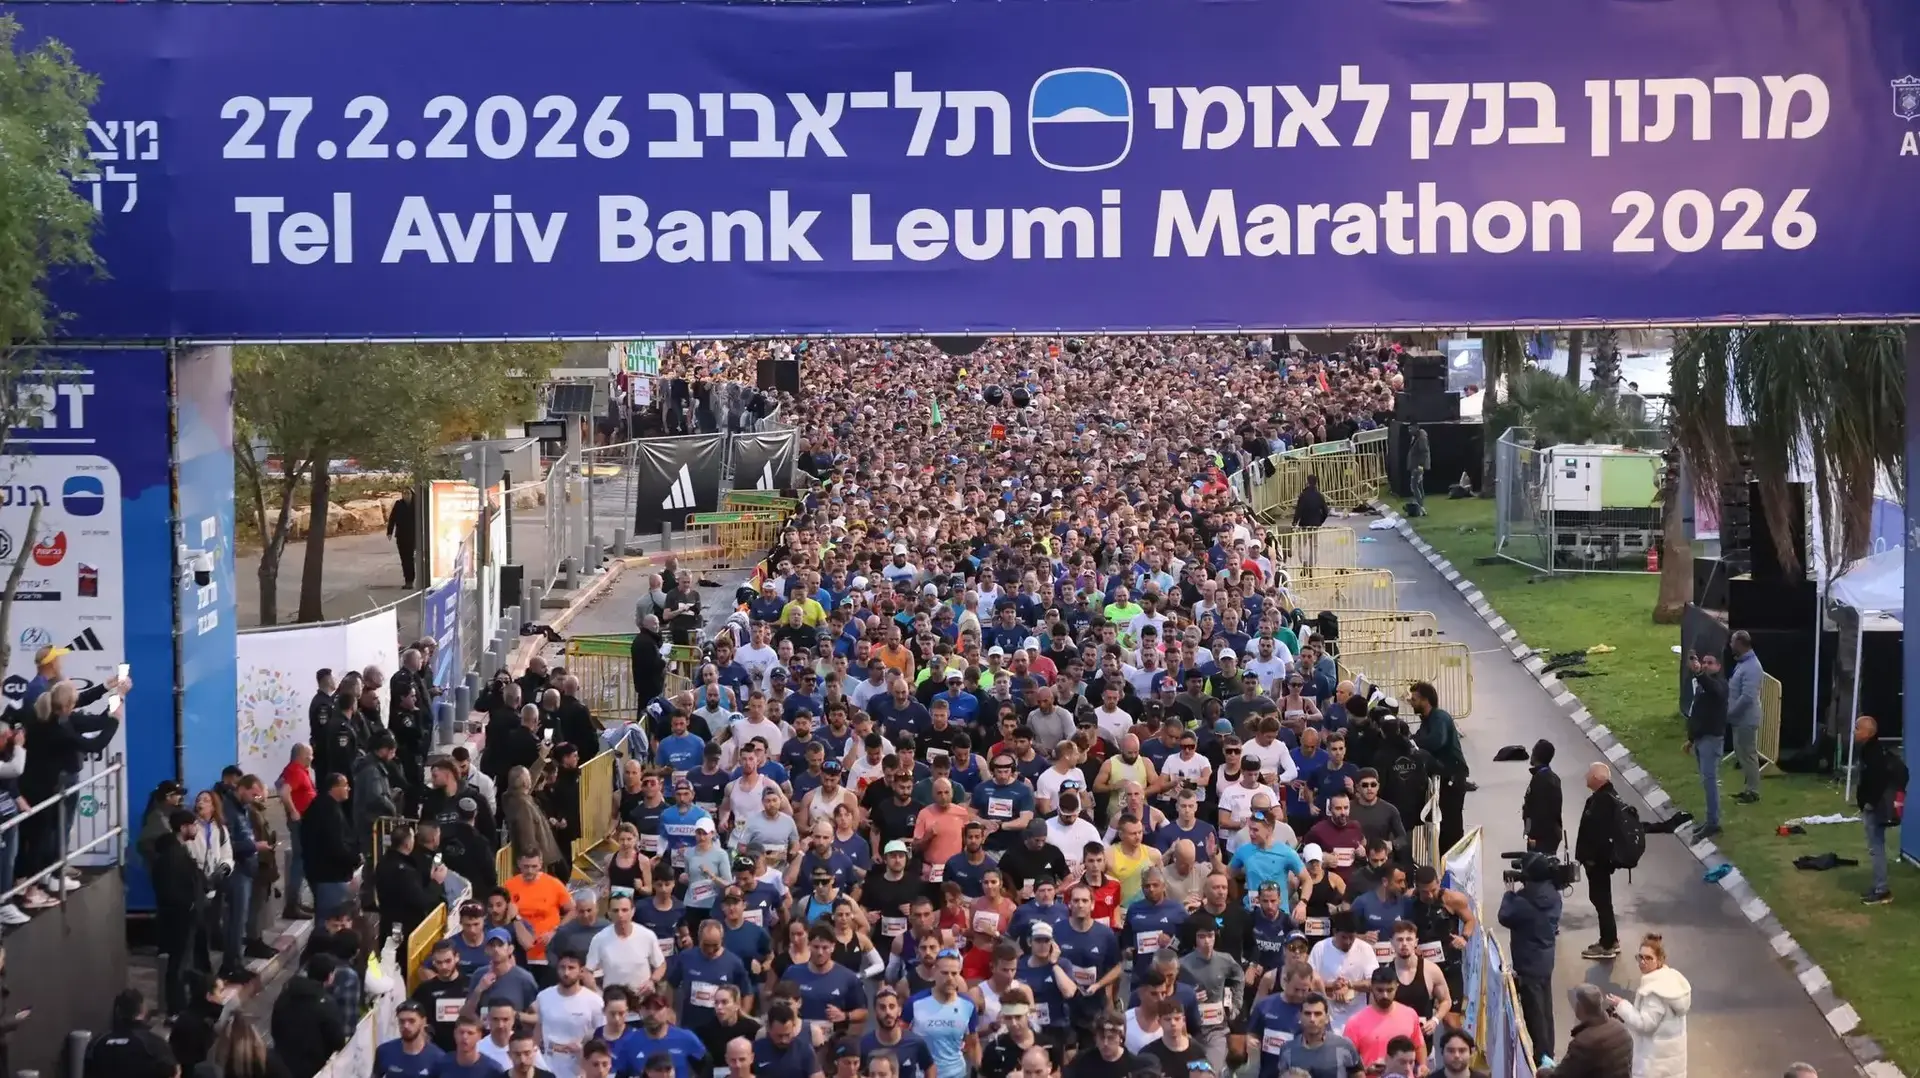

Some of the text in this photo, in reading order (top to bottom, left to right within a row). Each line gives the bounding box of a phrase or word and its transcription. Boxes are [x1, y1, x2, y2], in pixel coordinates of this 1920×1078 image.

[220, 95, 630, 160] 27.2.2026
[1148, 65, 1390, 150] לאומי
[1410, 82, 1566, 160] בנק
[1584, 74, 1830, 158] מרתון
[1899, 131, 1920, 156] A
[234, 182, 1817, 265] Tel Aviv Bank Leumi Marathon 2026
[8, 384, 95, 429] RT
[4, 683, 27, 693] GU
